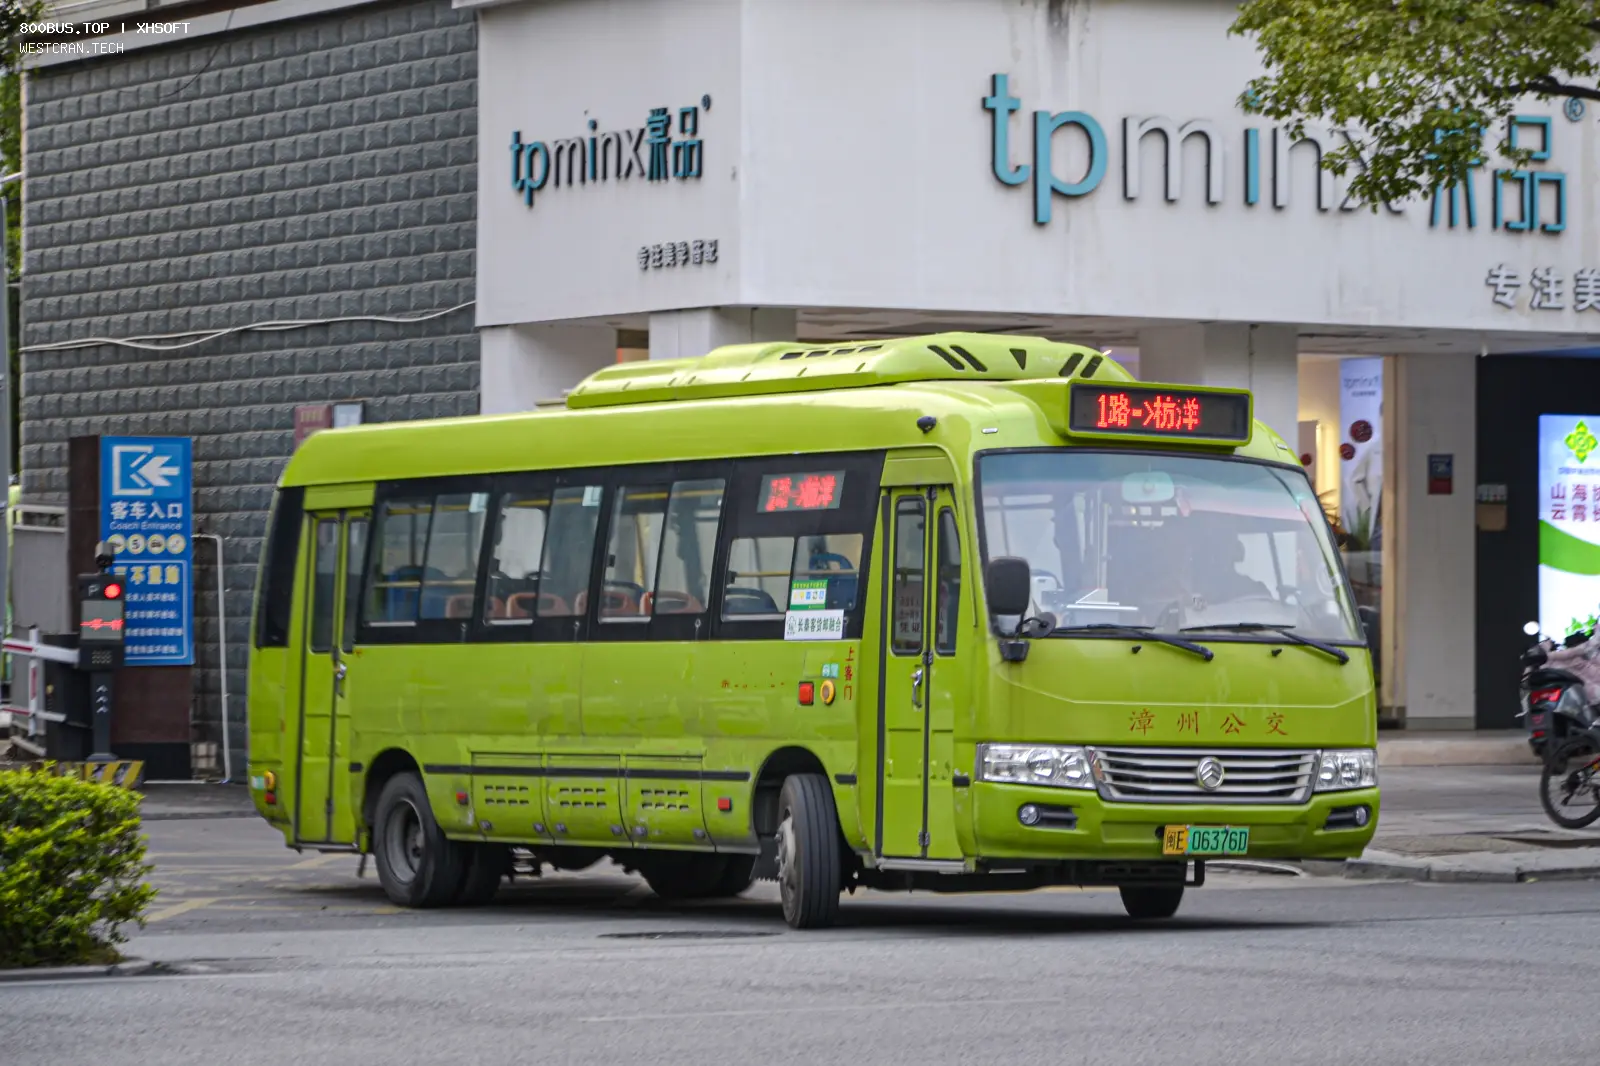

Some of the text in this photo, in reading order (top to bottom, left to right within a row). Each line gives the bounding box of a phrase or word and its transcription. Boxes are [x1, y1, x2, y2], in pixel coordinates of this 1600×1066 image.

[110, 501, 183, 519] 客车入口
[109, 520, 182, 530] Coach Entrance
[1128, 708, 1289, 737] 漳州公交
